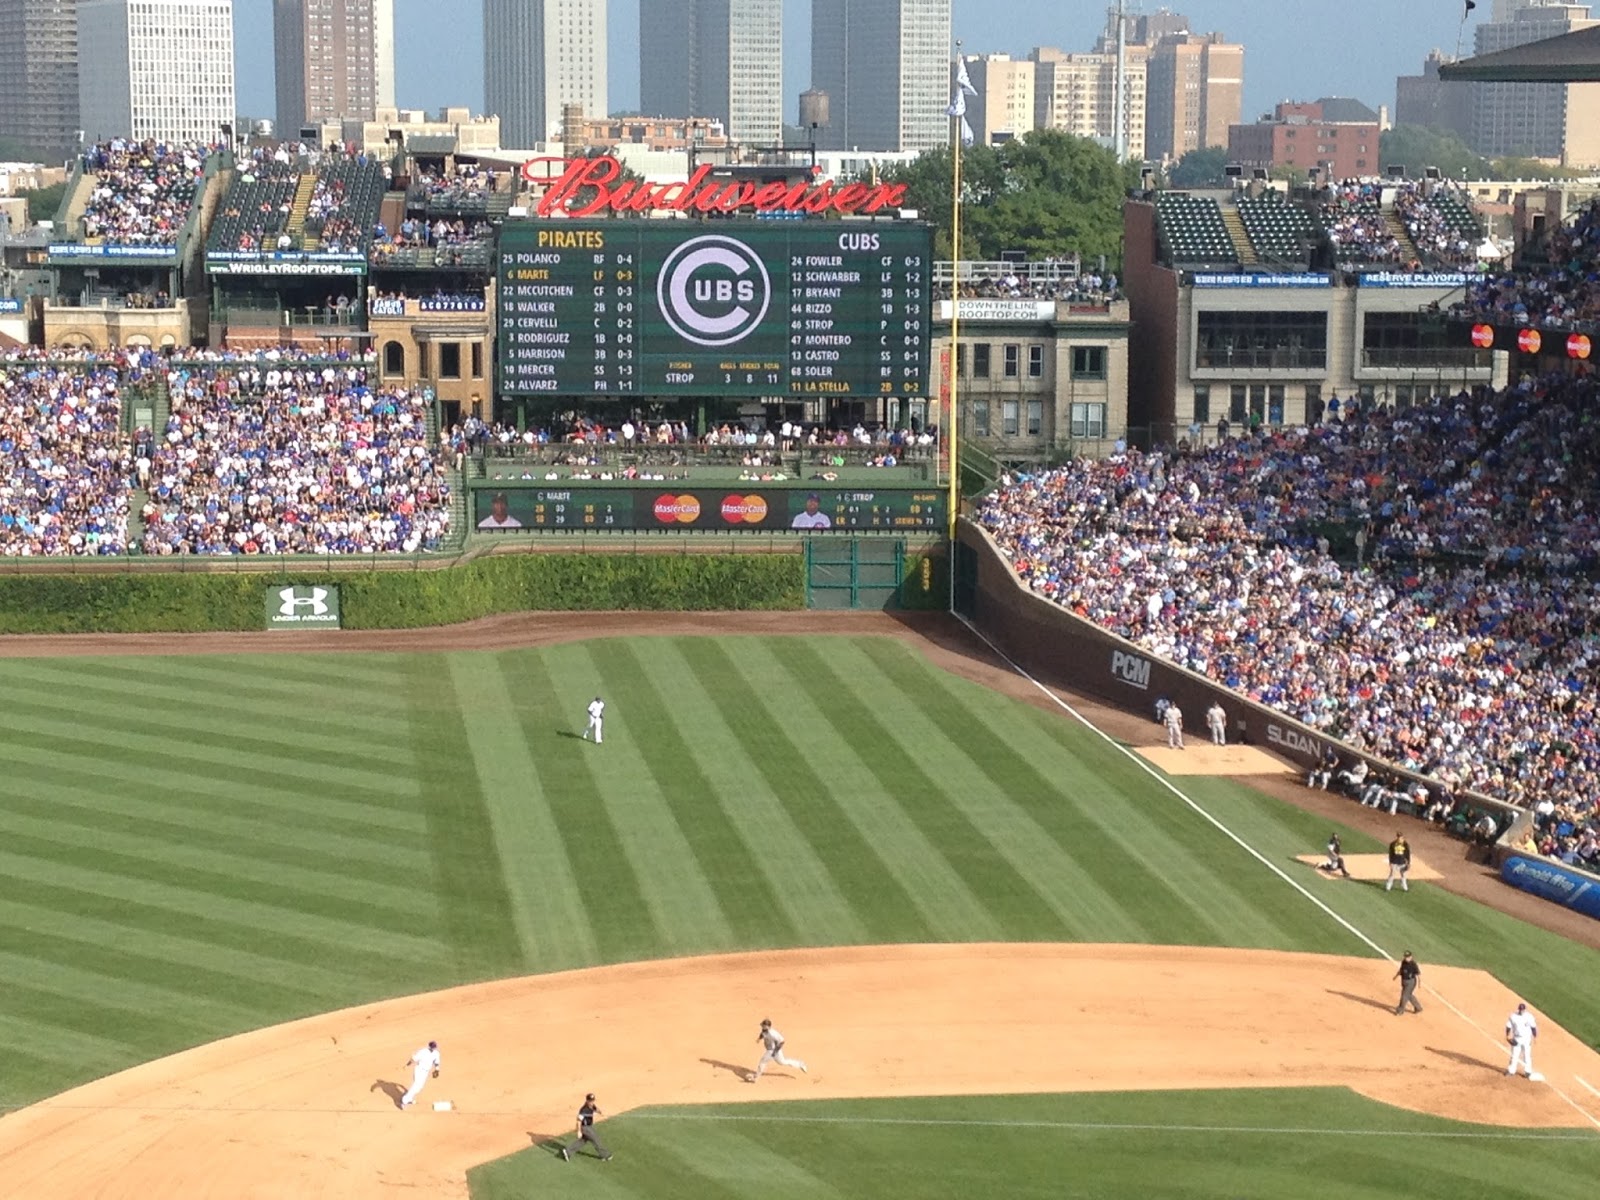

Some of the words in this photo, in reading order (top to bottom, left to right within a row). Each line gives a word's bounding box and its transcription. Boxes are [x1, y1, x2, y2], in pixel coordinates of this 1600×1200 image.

[521, 155, 909, 217] Budweiser
[538, 231, 604, 248] PIRATES
[838, 233, 880, 250] CUBS
[502, 254, 514, 264] 25
[517, 254, 560, 264] POLANCO
[594, 254, 604, 264] RF
[617, 254, 632, 264] 0-4
[791, 257, 802, 266] 24
[806, 257, 843, 266] FOWLER
[881, 257, 892, 266] CF
[905, 257, 920, 266] 0-3
[508, 270, 514, 280] 6
[517, 270, 549, 280] MARTE
[594, 270, 604, 280] LF
[617, 270, 632, 280] 0-3
[792, 272, 802, 282] 12
[806, 272, 860, 282] SCHWARBER
[881, 273, 892, 282] LF
[905, 273, 920, 282] 1-2
[1366, 274, 1412, 282] RESERVE
[1414, 274, 1465, 282] PLAYOFFS
[503, 286, 514, 296] 22
[518, 286, 574, 296] MCCUTCHEN
[594, 286, 604, 296] CF
[617, 286, 632, 296] 0-3
[792, 288, 802, 297] 17
[806, 288, 841, 297] BRYANT
[881, 289, 892, 298] 3B
[905, 289, 920, 298] 1-3
[518, 302, 555, 312] WALKER
[594, 303, 605, 312] 2B
[618, 303, 632, 312] 0-0
[791, 304, 802, 313] 44
[806, 304, 832, 313] RIZZO
[881, 305, 892, 314] 1B
[905, 305, 920, 314] 1-3
[504, 318, 514, 328] 29
[518, 318, 558, 328] CERVELLI
[594, 319, 600, 328] C
[618, 319, 632, 328] 0-2
[805, 320, 834, 330] STROP
[881, 321, 887, 330] P
[904, 321, 920, 330] 0-0
[518, 333, 570, 343] RODRIGUEZ
[594, 334, 606, 344] 1B
[618, 334, 632, 344] 0-0
[791, 336, 801, 345] 47
[805, 336, 851, 345] MONTERO
[881, 336, 886, 345] C
[904, 336, 920, 345] 0-0
[509, 349, 514, 359] 5
[518, 349, 565, 359] HARRISON
[594, 350, 606, 359] 3B
[618, 350, 632, 359] 0-3
[805, 351, 839, 360] CASTRO
[881, 352, 891, 361] SS
[904, 352, 918, 361] 0-1
[518, 365, 555, 375] MERCER
[594, 366, 604, 375] SS
[618, 366, 632, 375] 1-3
[805, 367, 832, 376] SOLER
[904, 367, 918, 377] 0-1
[666, 373, 694, 383] STROP
[725, 374, 731, 383] 3
[747, 374, 753, 383] 8
[768, 374, 778, 383] 11
[504, 381, 514, 390] 24
[518, 381, 558, 390] ALVAREZ
[618, 381, 632, 390] 1-1
[791, 382, 800, 391] 11
[805, 382, 817, 391] LA
[819, 382, 850, 391] STELLA
[881, 383, 892, 392] 2B
[904, 383, 919, 392] 0-2
[546, 492, 570, 500] MARTE
[853, 493, 874, 501] STROP
[655, 504, 700, 513] MasterCard
[722, 504, 767, 513] MasterCard
[1111, 650, 1151, 685] PCM
[1267, 724, 1321, 758] SLOAN
